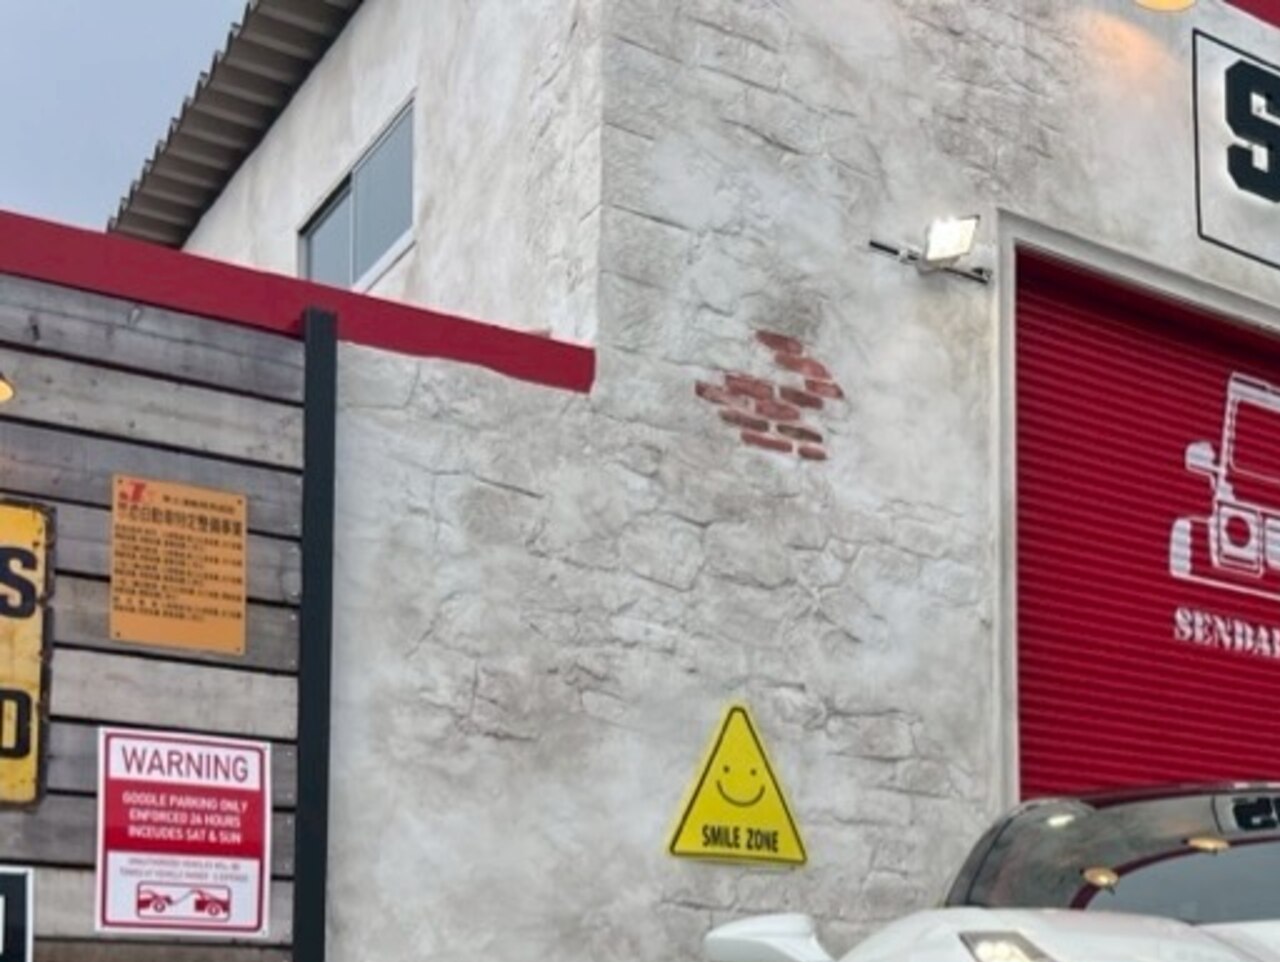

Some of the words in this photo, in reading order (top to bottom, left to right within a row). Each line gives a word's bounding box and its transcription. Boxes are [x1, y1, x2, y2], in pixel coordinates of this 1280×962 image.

[122, 745, 248, 783] WARNING
[169, 794, 218, 810] PARKING
[220, 798, 248, 813] ONLY
[129, 807, 188, 824] ENFORCED
[204, 813, 240, 828] HOURS
[186, 827, 206, 842] SAT
[219, 830, 242, 845] SUN
[701, 824, 740, 848] SMILE
[746, 827, 779, 852] ZONE
